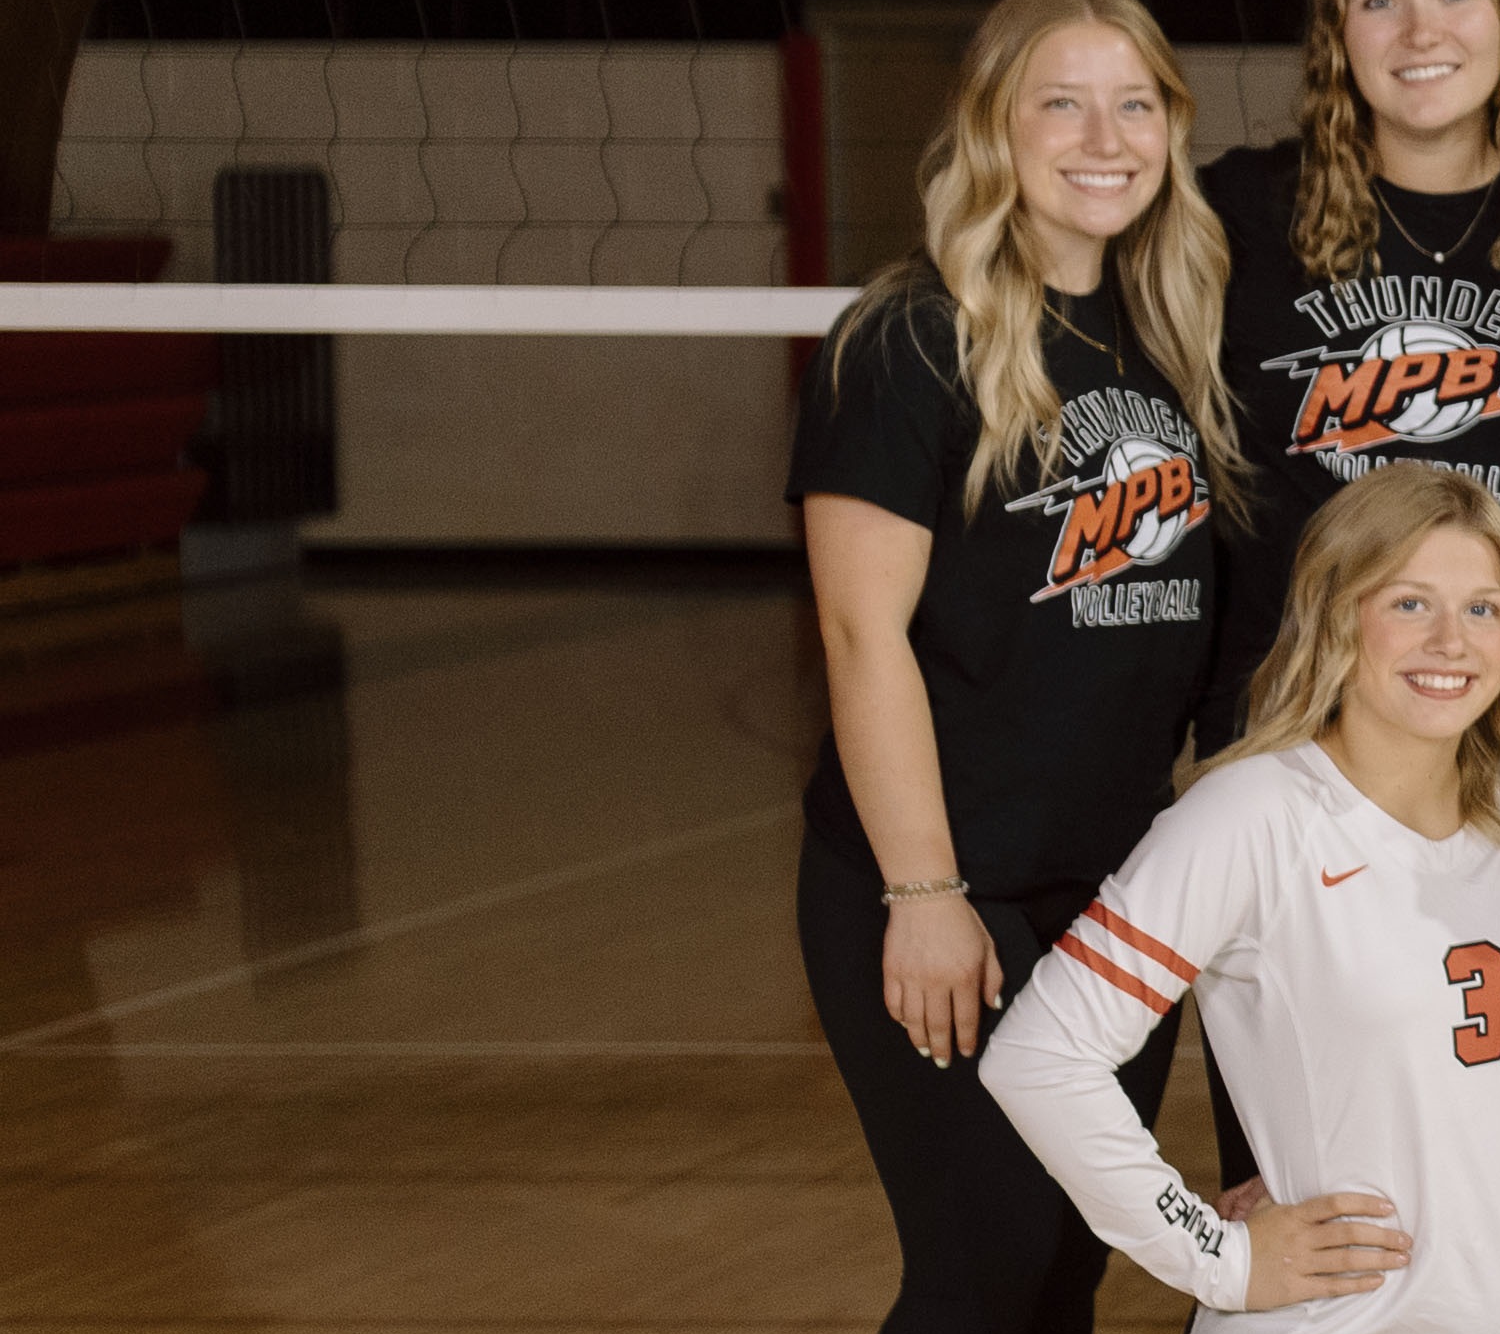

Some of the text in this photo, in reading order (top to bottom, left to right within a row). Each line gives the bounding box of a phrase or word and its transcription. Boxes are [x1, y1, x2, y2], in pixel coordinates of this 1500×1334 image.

[1296, 348, 1498, 444] MPB
[1052, 456, 1194, 581] MPB
[1071, 579, 1201, 628] VOLLEYBALL
